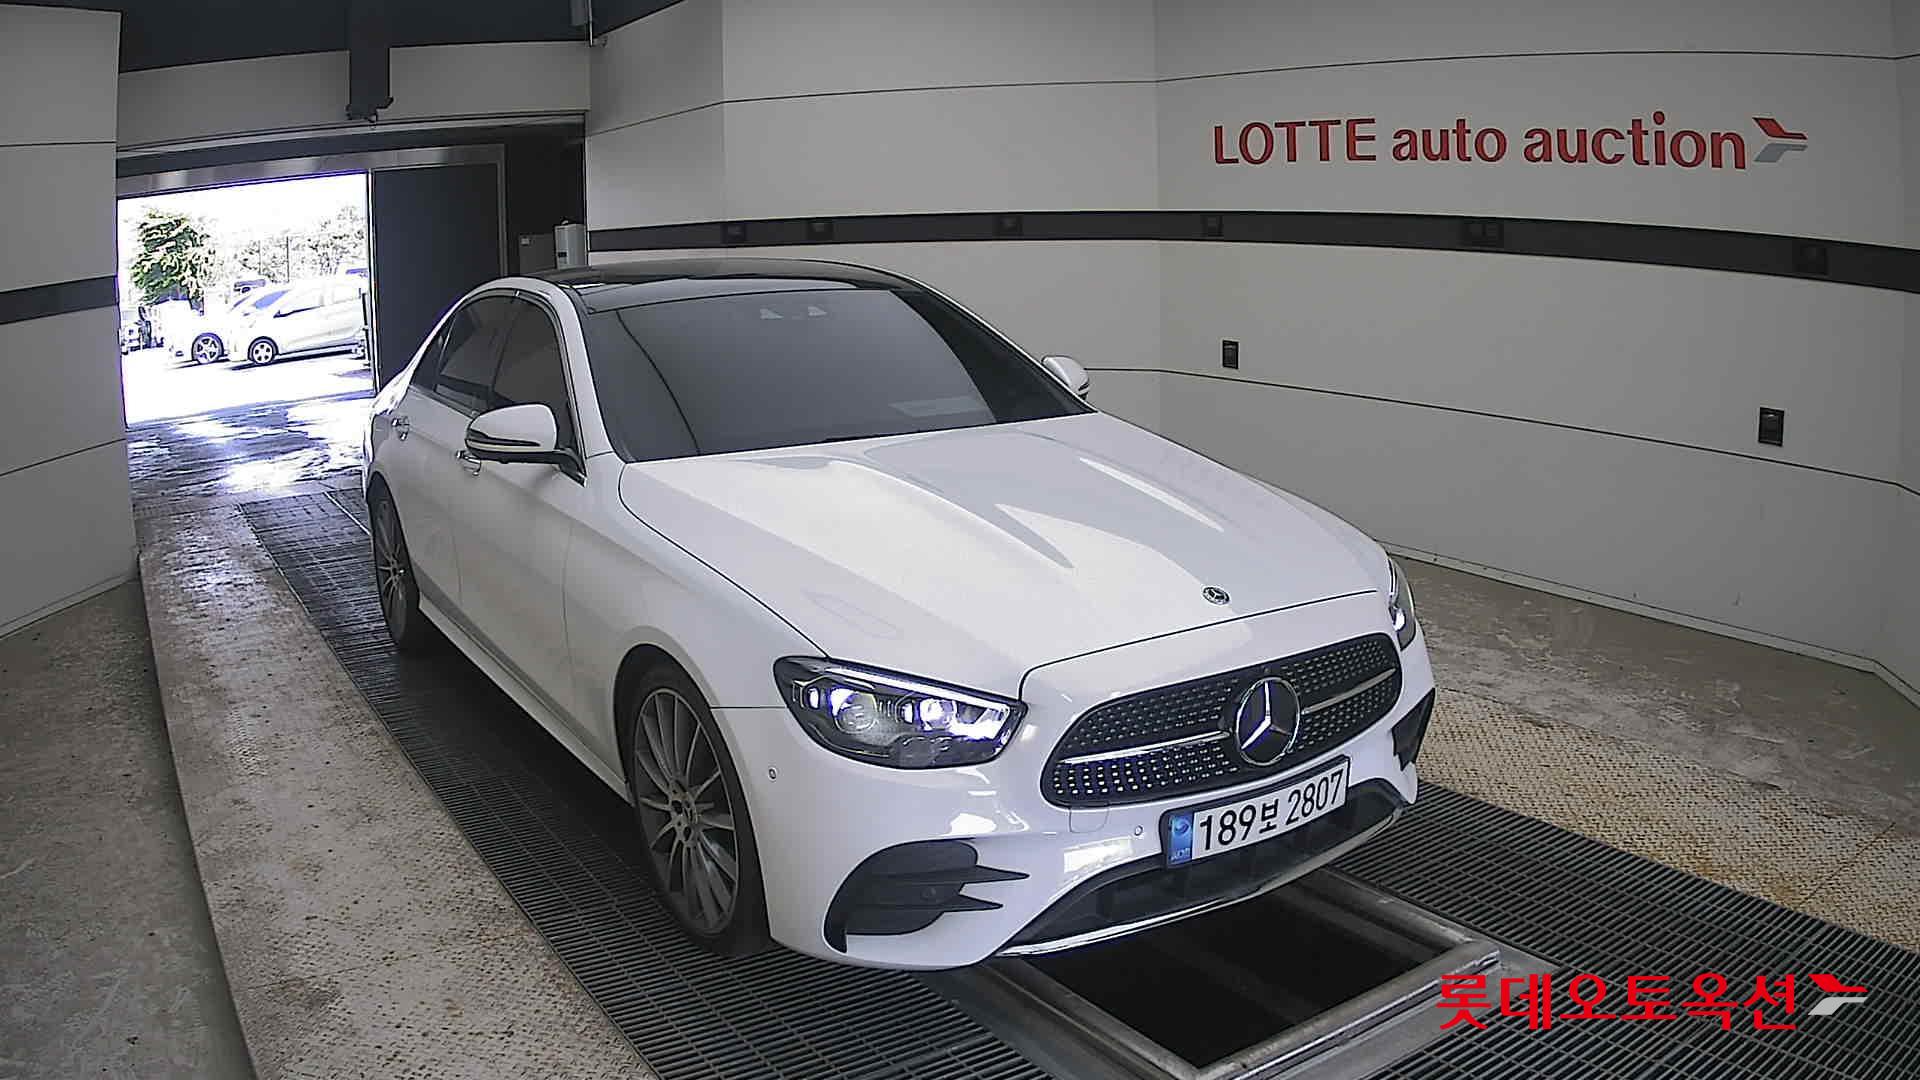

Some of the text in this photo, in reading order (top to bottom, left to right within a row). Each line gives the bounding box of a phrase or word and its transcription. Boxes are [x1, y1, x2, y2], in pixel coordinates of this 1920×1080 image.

[1214, 110, 1746, 170] LOTTE auto auction
[1199, 768, 1344, 851] 189보 2807
